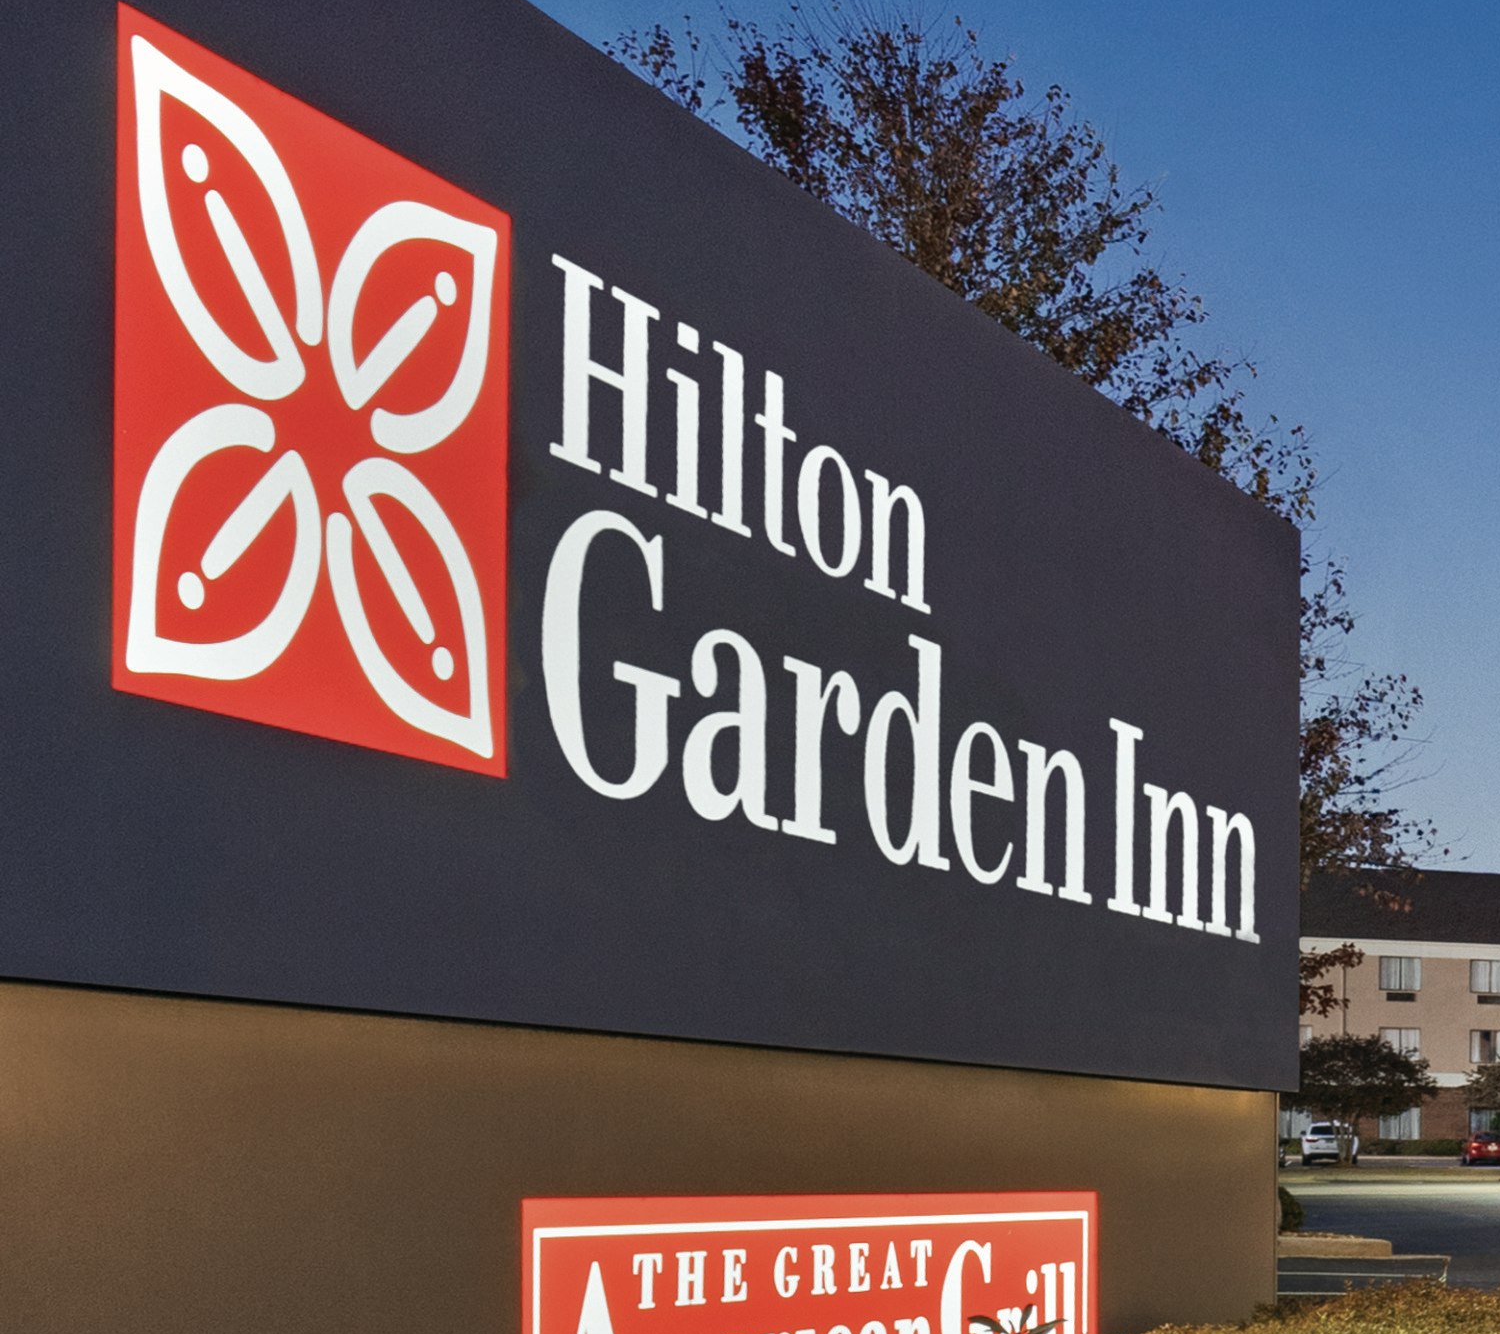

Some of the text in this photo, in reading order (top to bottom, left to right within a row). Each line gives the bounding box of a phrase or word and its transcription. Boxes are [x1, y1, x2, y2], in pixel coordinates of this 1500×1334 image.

[550, 252, 933, 616] Hilton
[541, 509, 1262, 944] Garden Inn
[632, 1239, 933, 1310] THE GREAT
